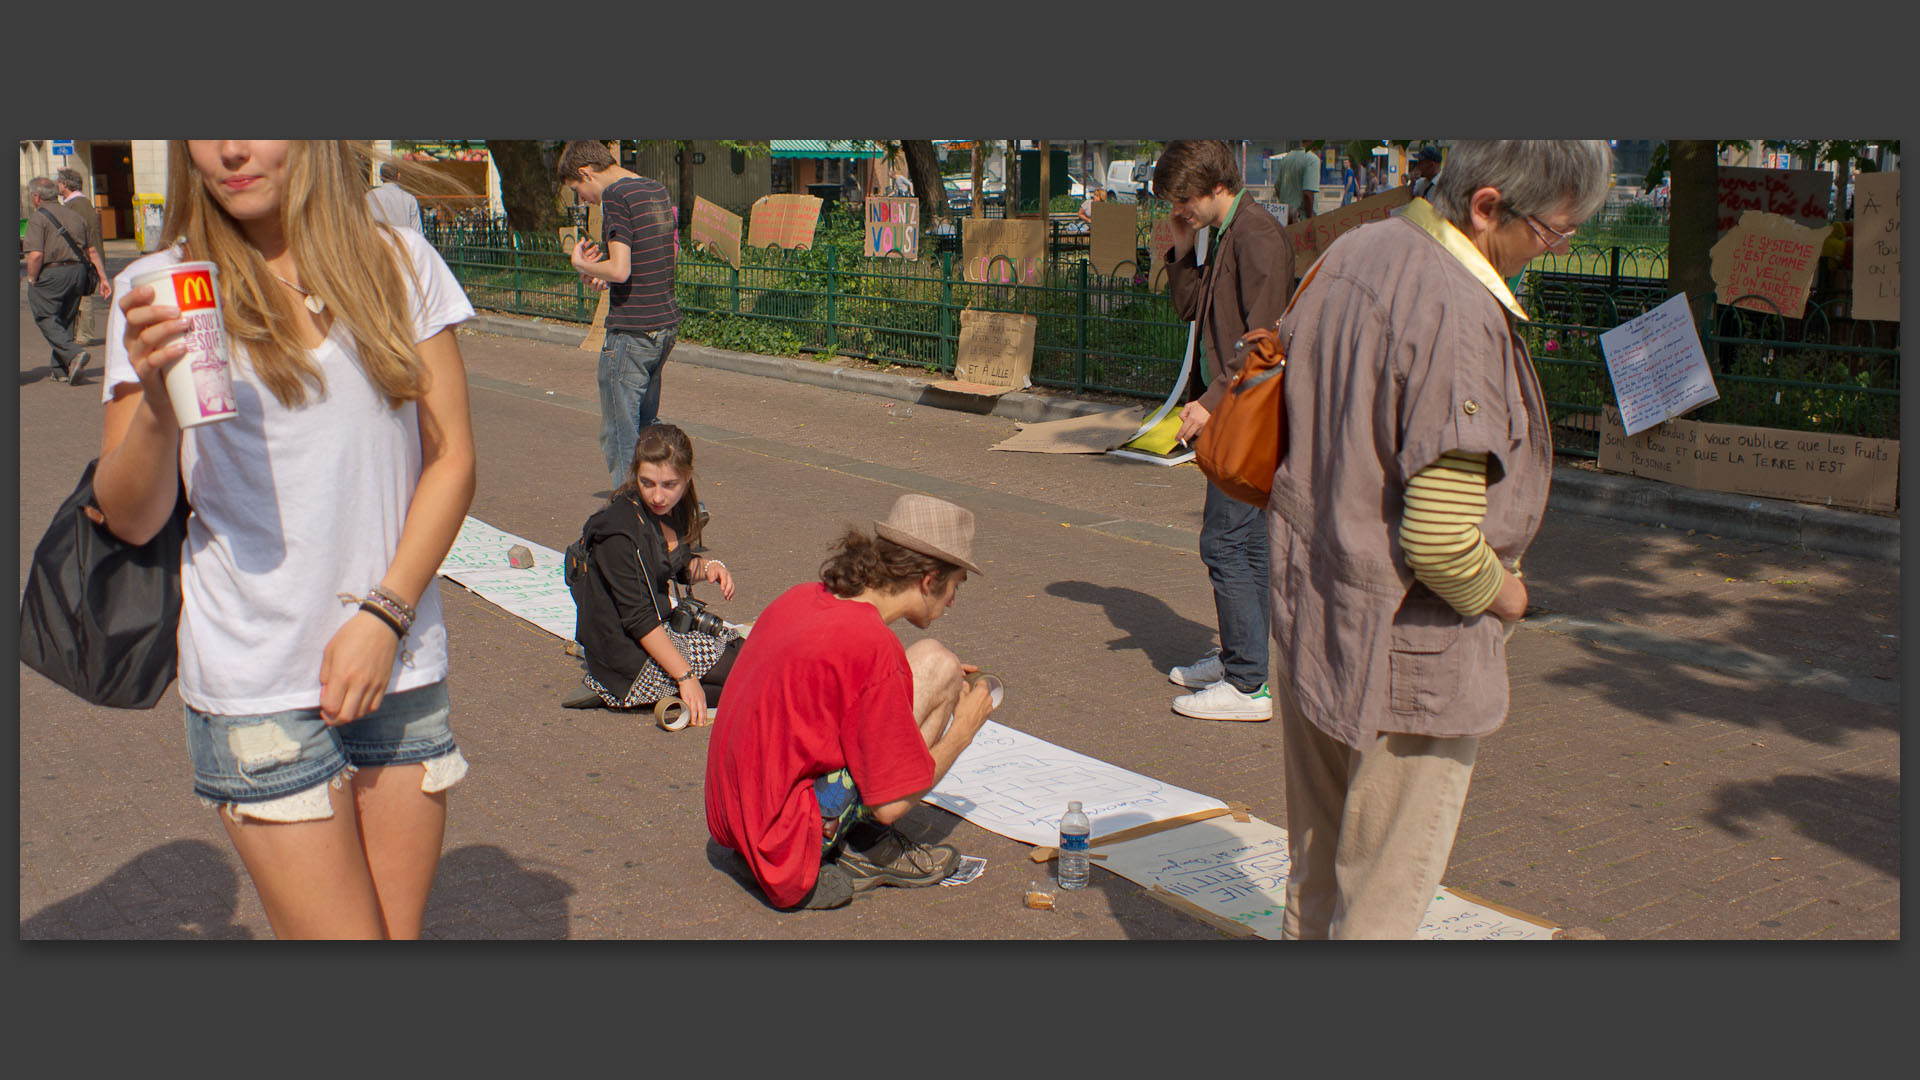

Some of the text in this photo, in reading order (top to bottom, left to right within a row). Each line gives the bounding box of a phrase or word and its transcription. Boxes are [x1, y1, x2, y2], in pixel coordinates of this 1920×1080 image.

[1743, 234, 1756, 248] LE
[968, 365, 979, 375] ET
[1704, 433, 1731, 446] Vous
[1797, 440, 1820, 453] que
[1827, 439, 1845, 455] les
[1675, 447, 1688, 458] ET
[1694, 450, 1719, 462] QUE
[1729, 452, 1745, 464] LA
